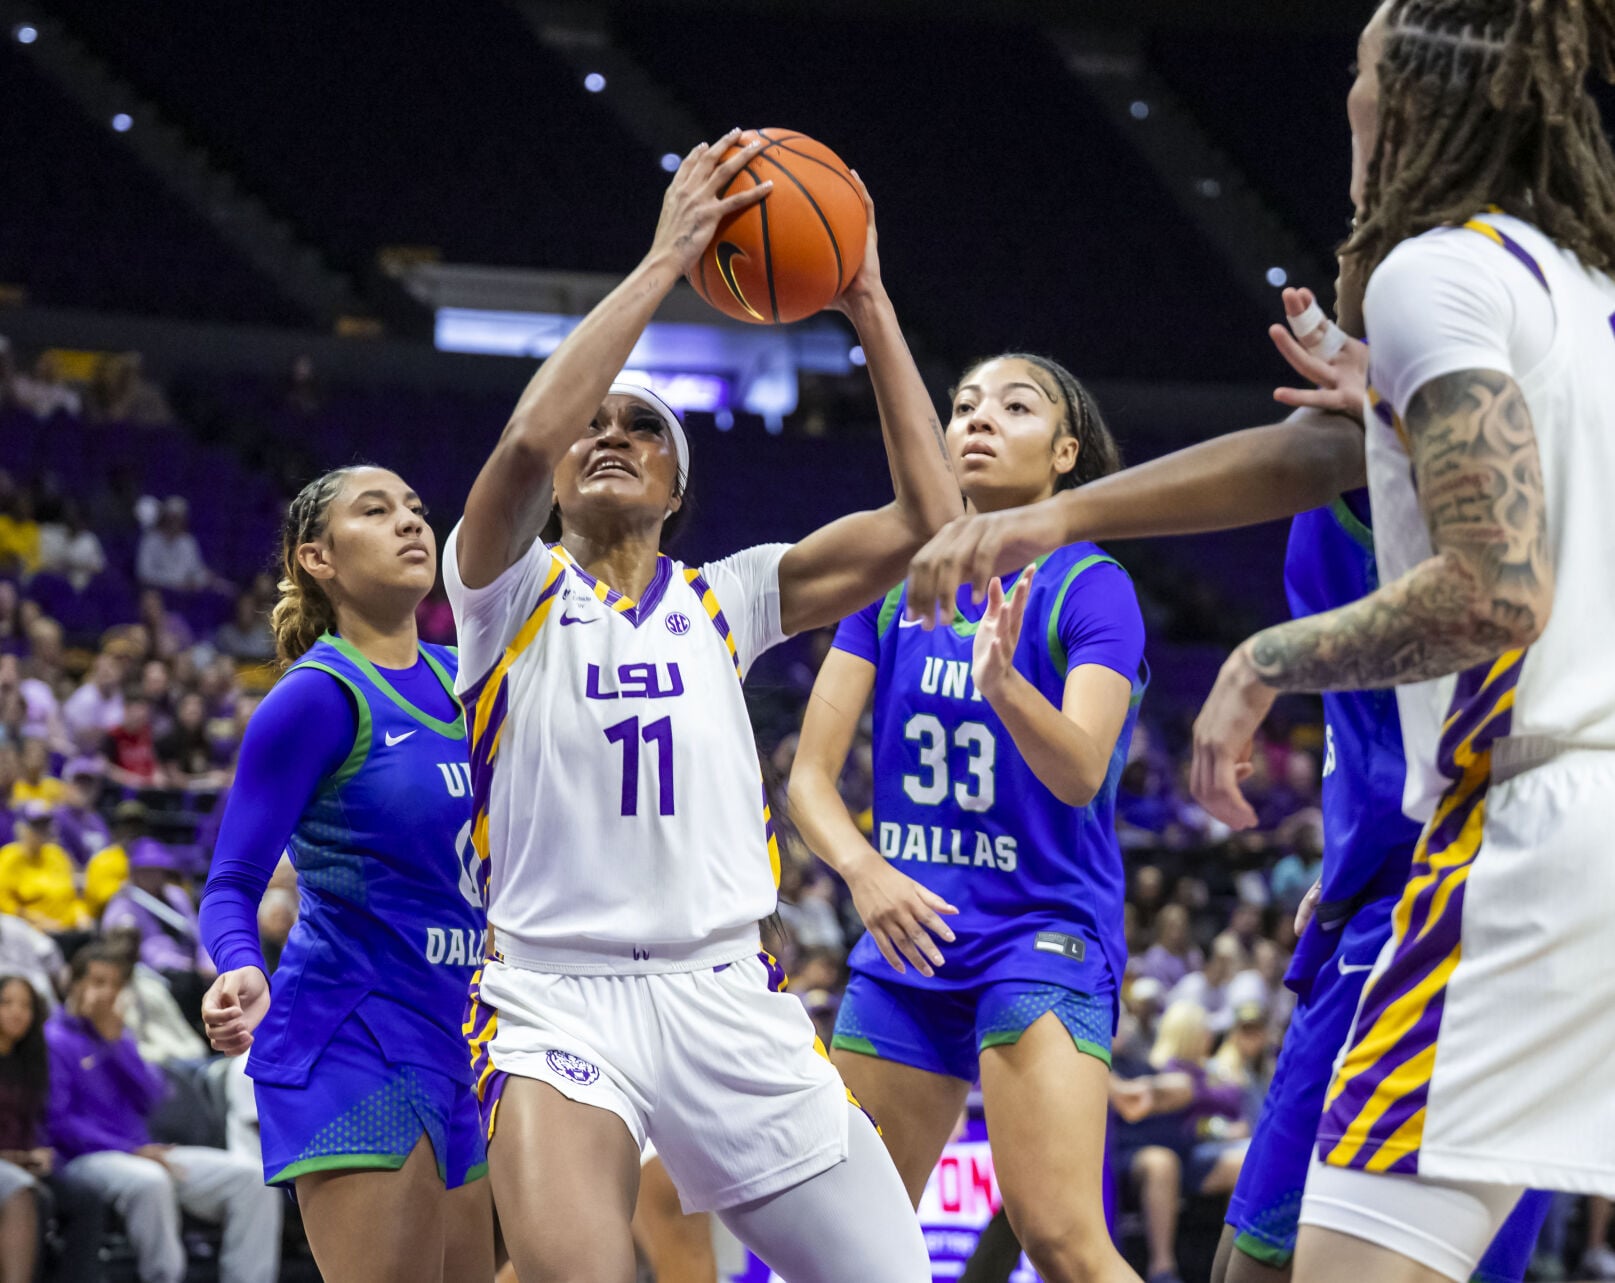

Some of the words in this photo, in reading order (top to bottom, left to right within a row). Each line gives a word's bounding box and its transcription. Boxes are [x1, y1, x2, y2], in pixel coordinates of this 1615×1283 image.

[667, 613, 689, 633] SEC
[586, 662, 685, 700] LSU
[603, 715, 675, 816] 11
[903, 713, 996, 813] 33
[879, 821, 1018, 872] DALLAS
